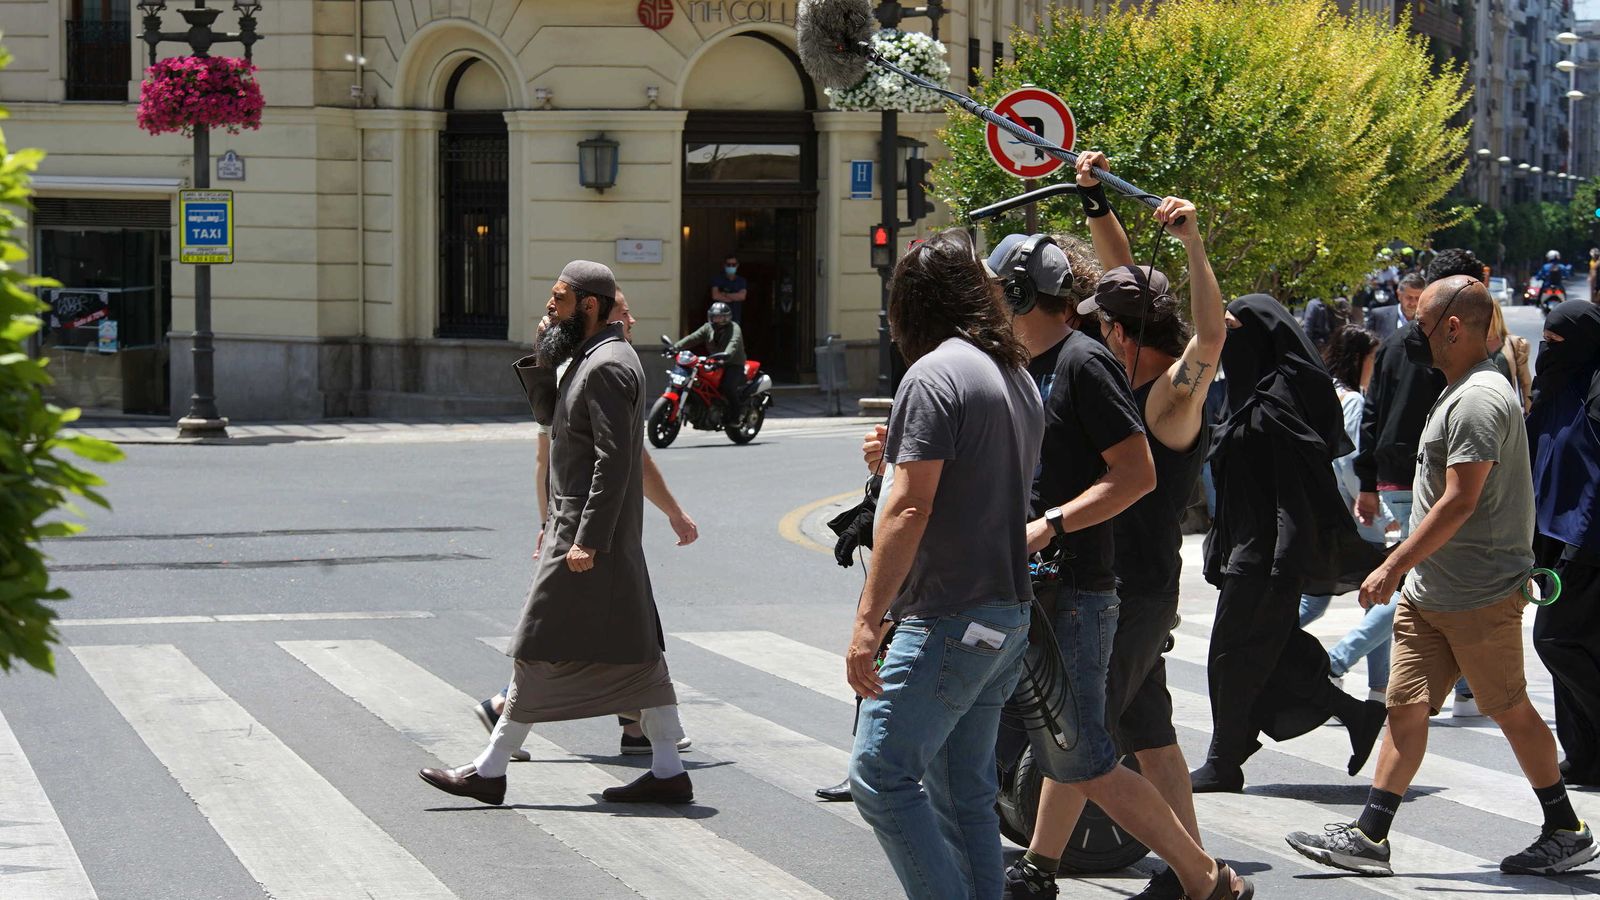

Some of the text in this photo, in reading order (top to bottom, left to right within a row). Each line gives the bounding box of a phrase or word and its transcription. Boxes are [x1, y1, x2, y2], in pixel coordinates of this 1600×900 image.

[729, 0, 798, 23] COLL
[857, 164, 867, 182] H
[192, 228, 222, 239] TAXI
[1370, 803, 1395, 816] adidas
